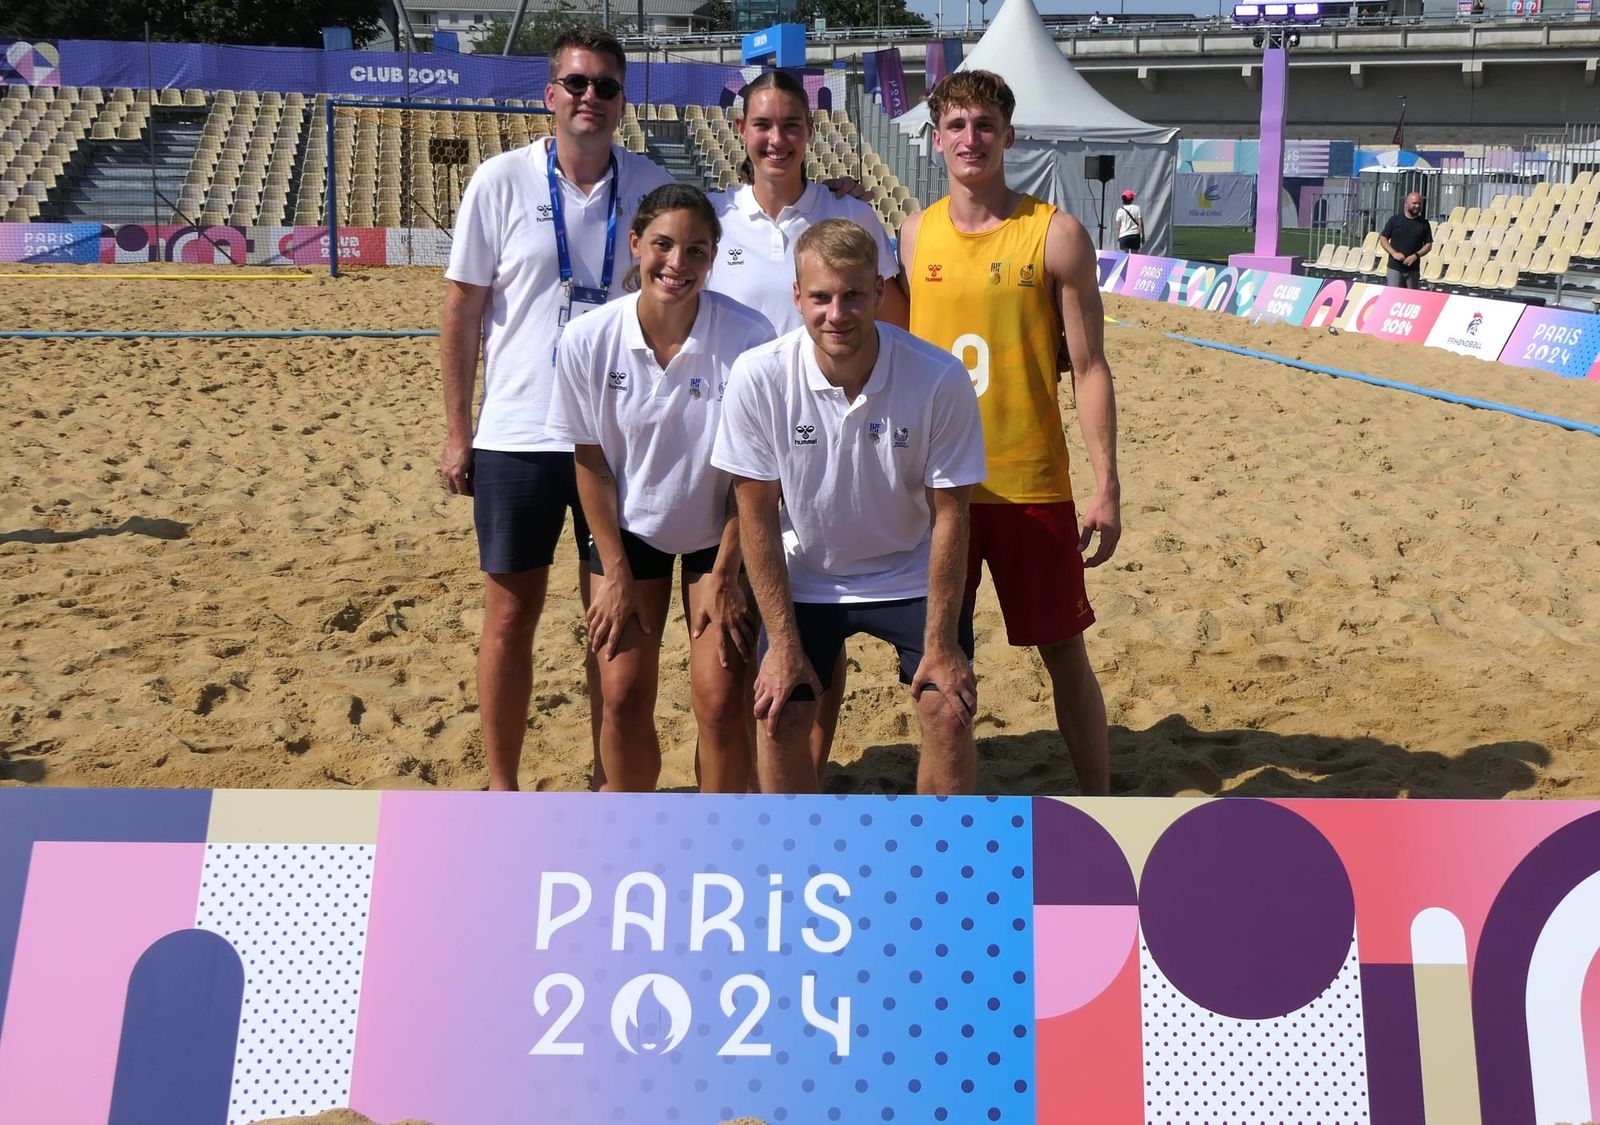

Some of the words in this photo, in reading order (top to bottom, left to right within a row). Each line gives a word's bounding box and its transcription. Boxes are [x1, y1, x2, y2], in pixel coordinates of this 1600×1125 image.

[350, 66, 404, 82] CLUB
[408, 68, 459, 84] 2024
[320, 235, 359, 247] CUB
[321, 247, 360, 258] 224
[1133, 279, 1157, 293] 2024
[1273, 284, 1302, 300] CLUB
[1265, 301, 1295, 317] 2024
[1389, 301, 1422, 319] CLUB
[1380, 319, 1412, 337] 2024
[1522, 343, 1571, 367] 2024
[951, 333, 989, 398] 9
[794, 438, 818, 446] hummel
[528, 972, 851, 1056] 2024
